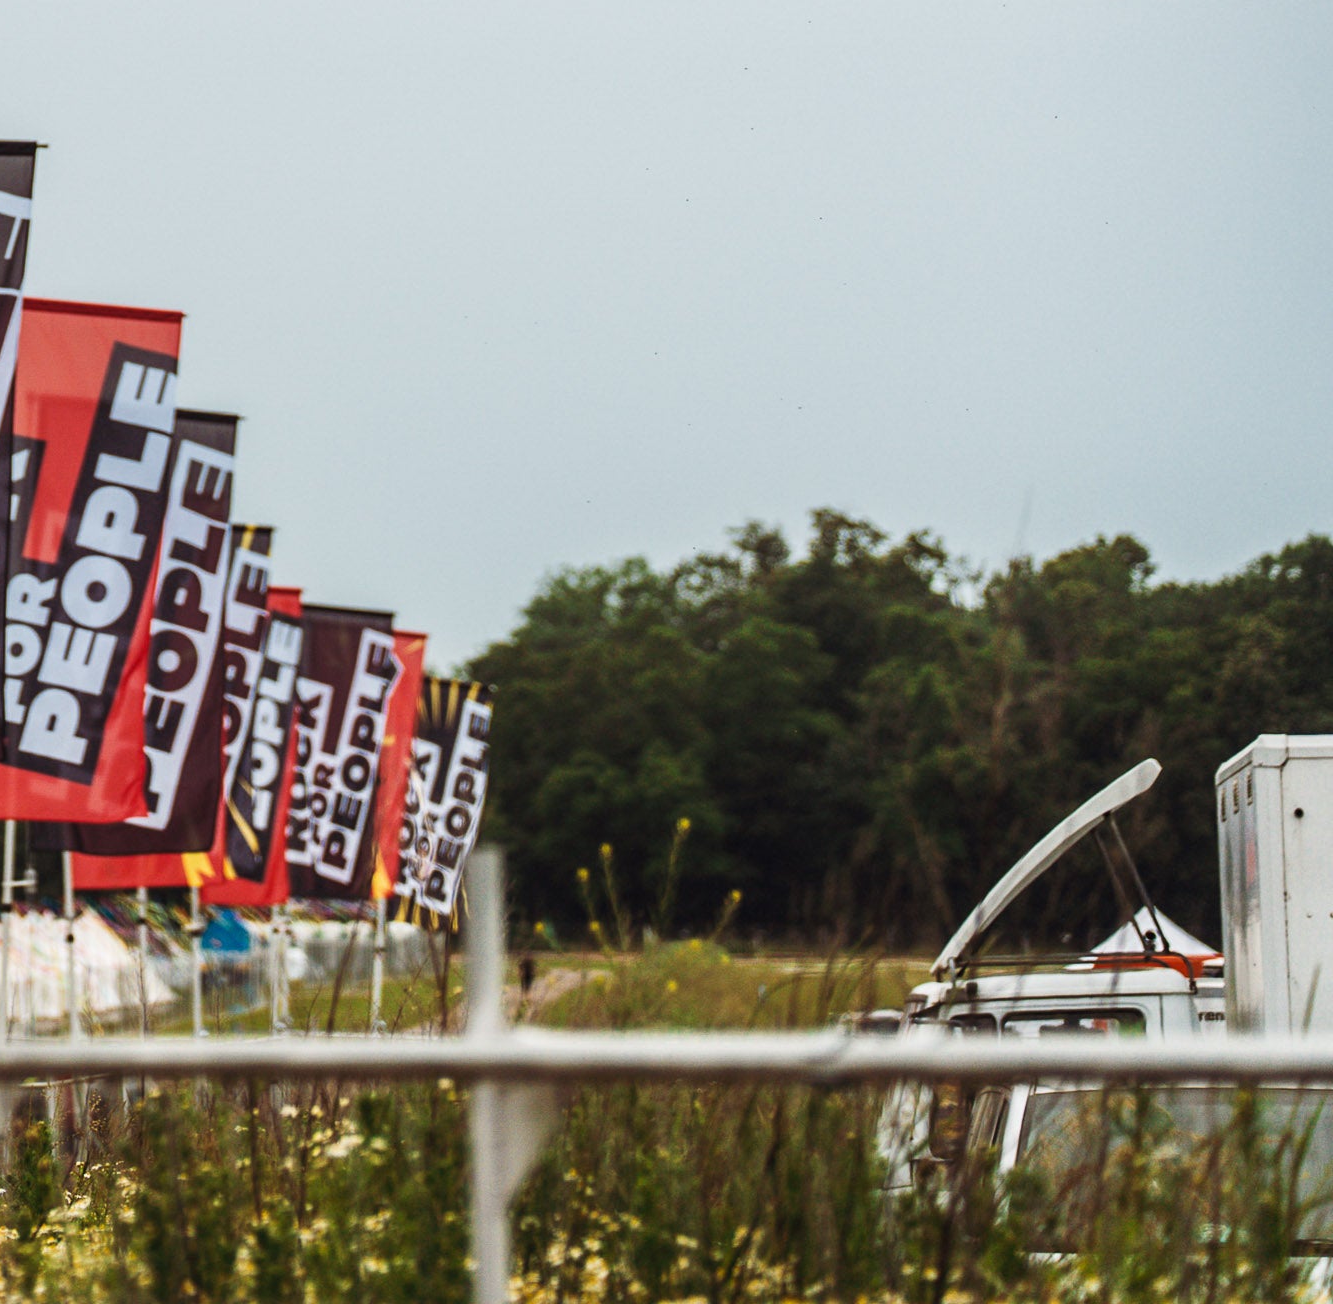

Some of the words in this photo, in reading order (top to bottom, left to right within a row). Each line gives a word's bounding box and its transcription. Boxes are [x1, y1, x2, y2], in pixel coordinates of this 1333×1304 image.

[17, 360, 177, 765] PEOPLE
[321, 642, 399, 870] PEOPLE
[424, 712, 491, 903] PEOPLE
